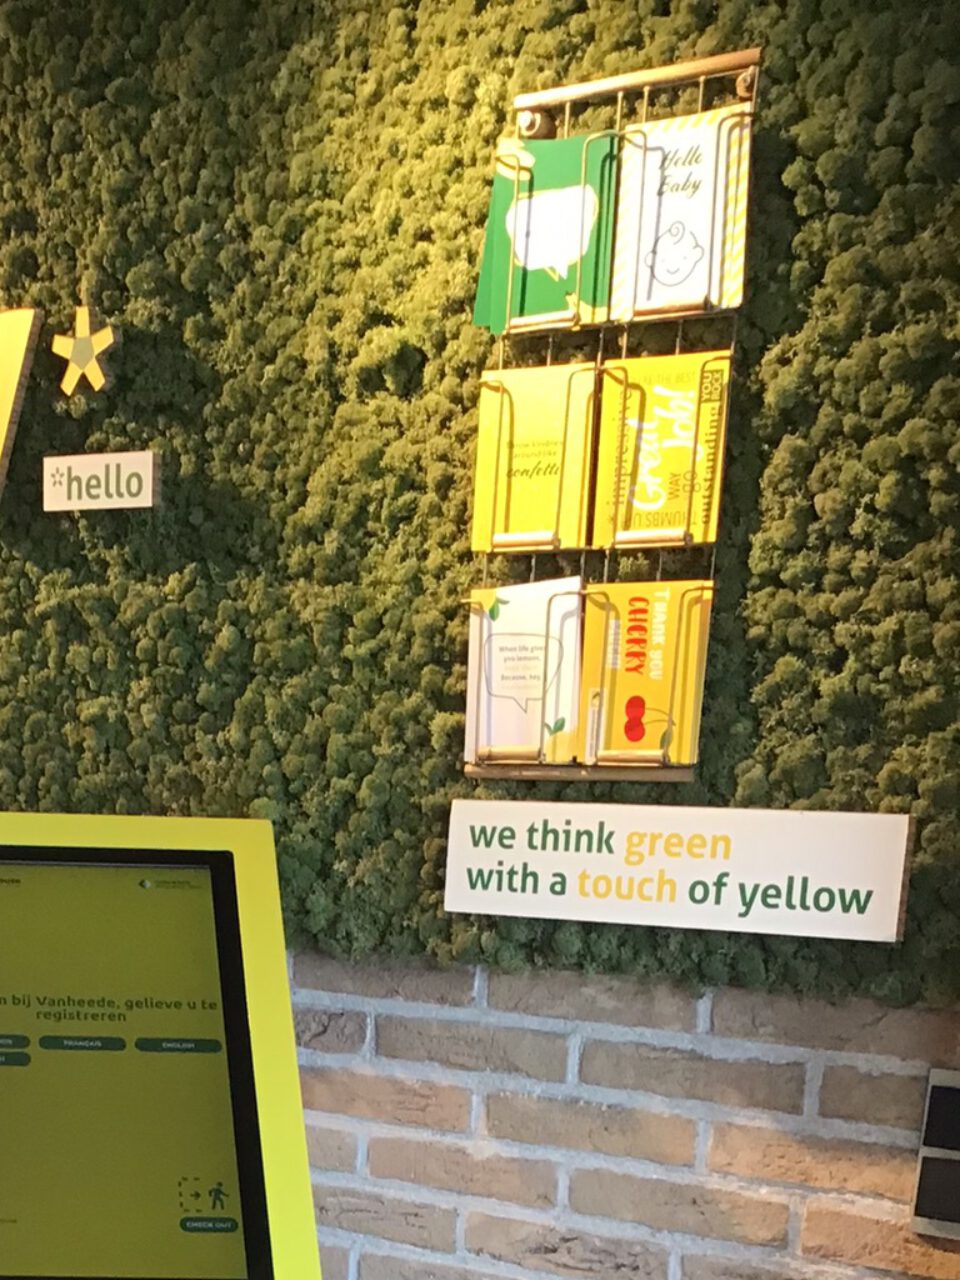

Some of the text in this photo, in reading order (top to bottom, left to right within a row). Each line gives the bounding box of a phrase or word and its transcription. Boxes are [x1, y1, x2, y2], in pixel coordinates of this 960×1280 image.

[624, 596, 650, 676] CHERRY
[470, 819, 732, 866] we think green
[467, 861, 874, 918] with a touch of yellow
[11, 994, 31, 1008] bij
[125, 997, 182, 1011] gelieve
[187, 1000, 197, 1009] u
[202, 999, 218, 1010] te
[36, 1010, 127, 1022] registreren
